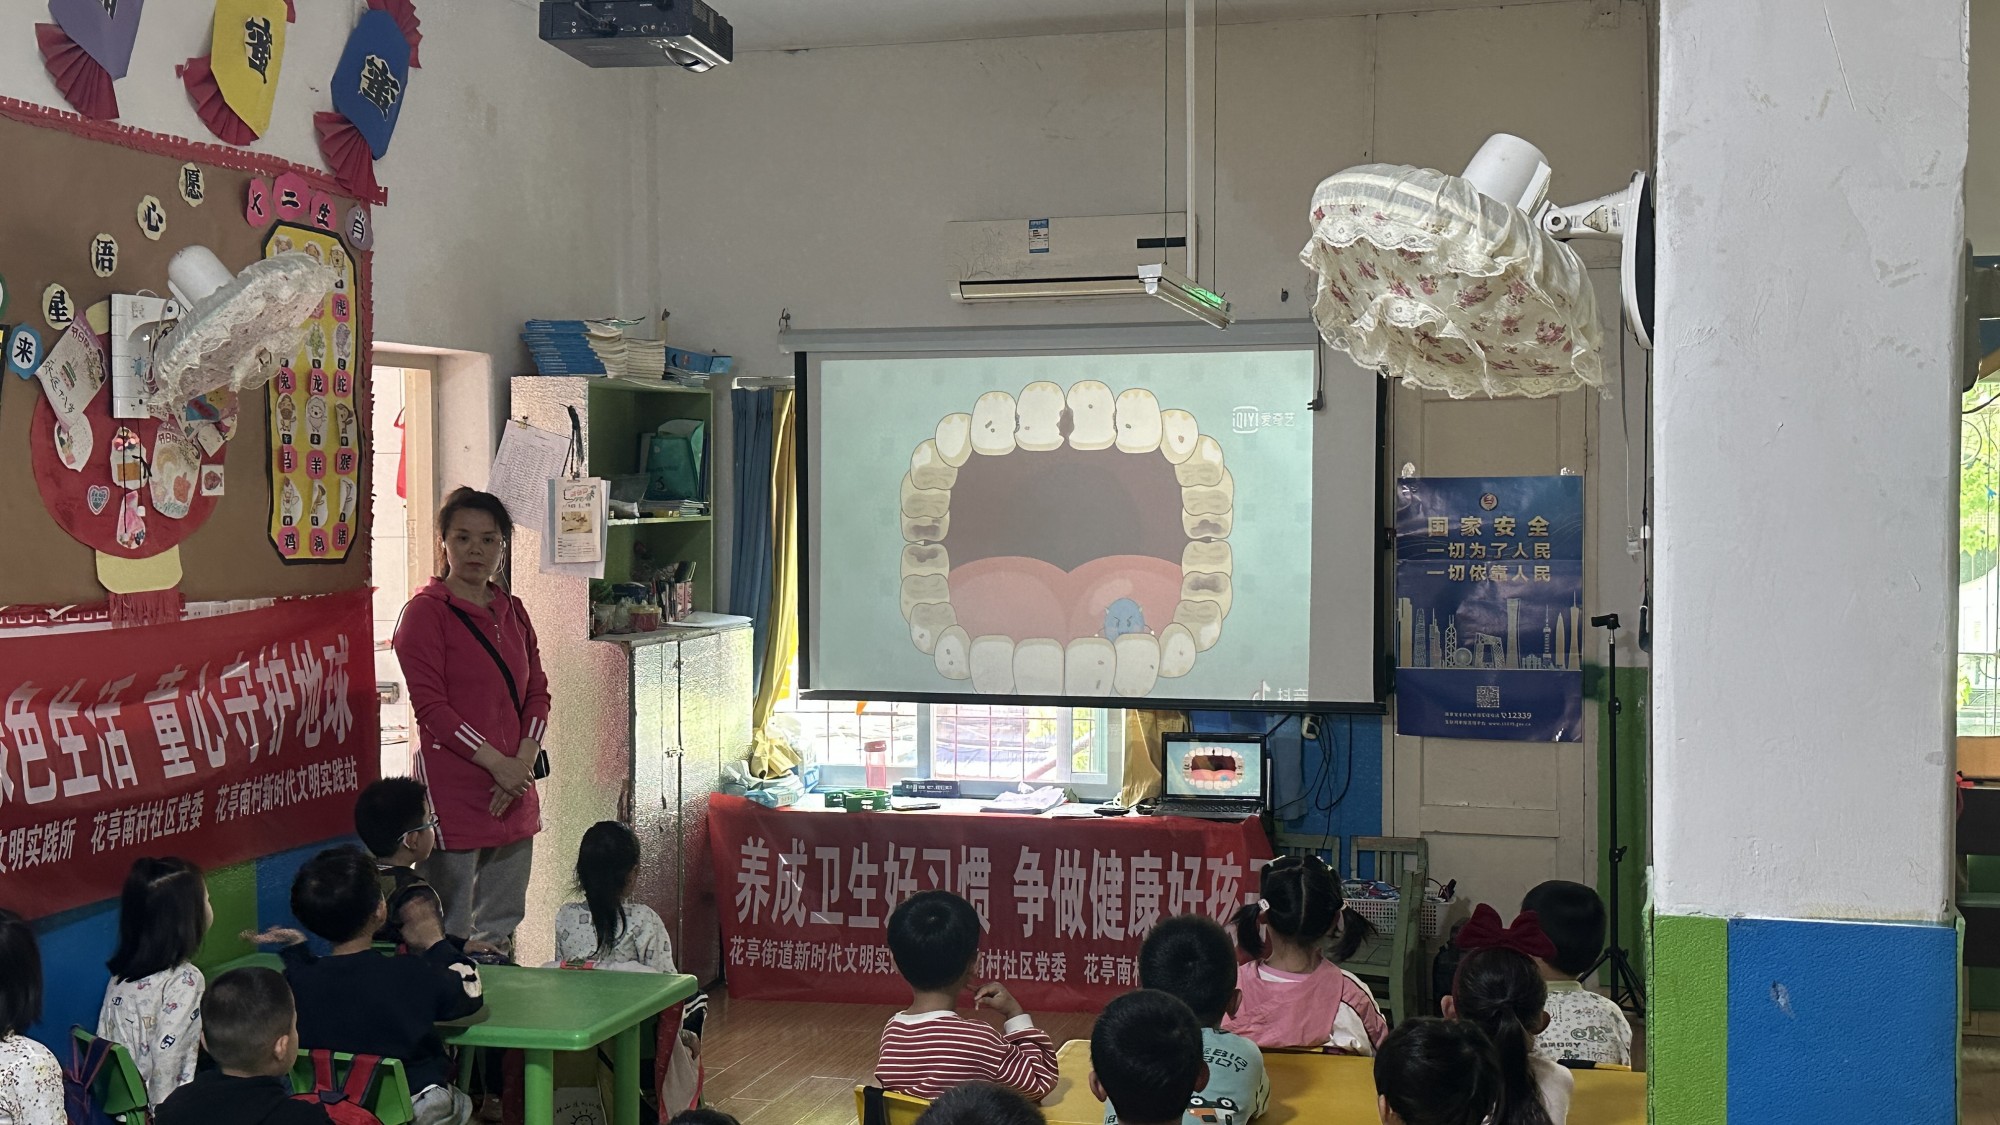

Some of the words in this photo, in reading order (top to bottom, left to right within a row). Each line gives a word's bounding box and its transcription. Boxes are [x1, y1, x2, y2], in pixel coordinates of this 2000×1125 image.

[14, 337, 33, 363] 来
[97, 239, 115, 272] 语
[144, 201, 164, 232] 心
[184, 167, 203, 200] 愿
[1428, 516, 1549, 537] 国家安全
[1427, 542, 1551, 559] 一切为了人民
[1427, 564, 1551, 581] 一切依靠人民
[144, 634, 353, 779] 童心守护地球
[1508, 711, 1532, 719] 12339
[91, 790, 204, 855] 花亭南村社区党委
[215, 755, 358, 824] 花亭南村新时代文明实践站
[729, 935, 899, 975] 花亭街道新时代文明实
